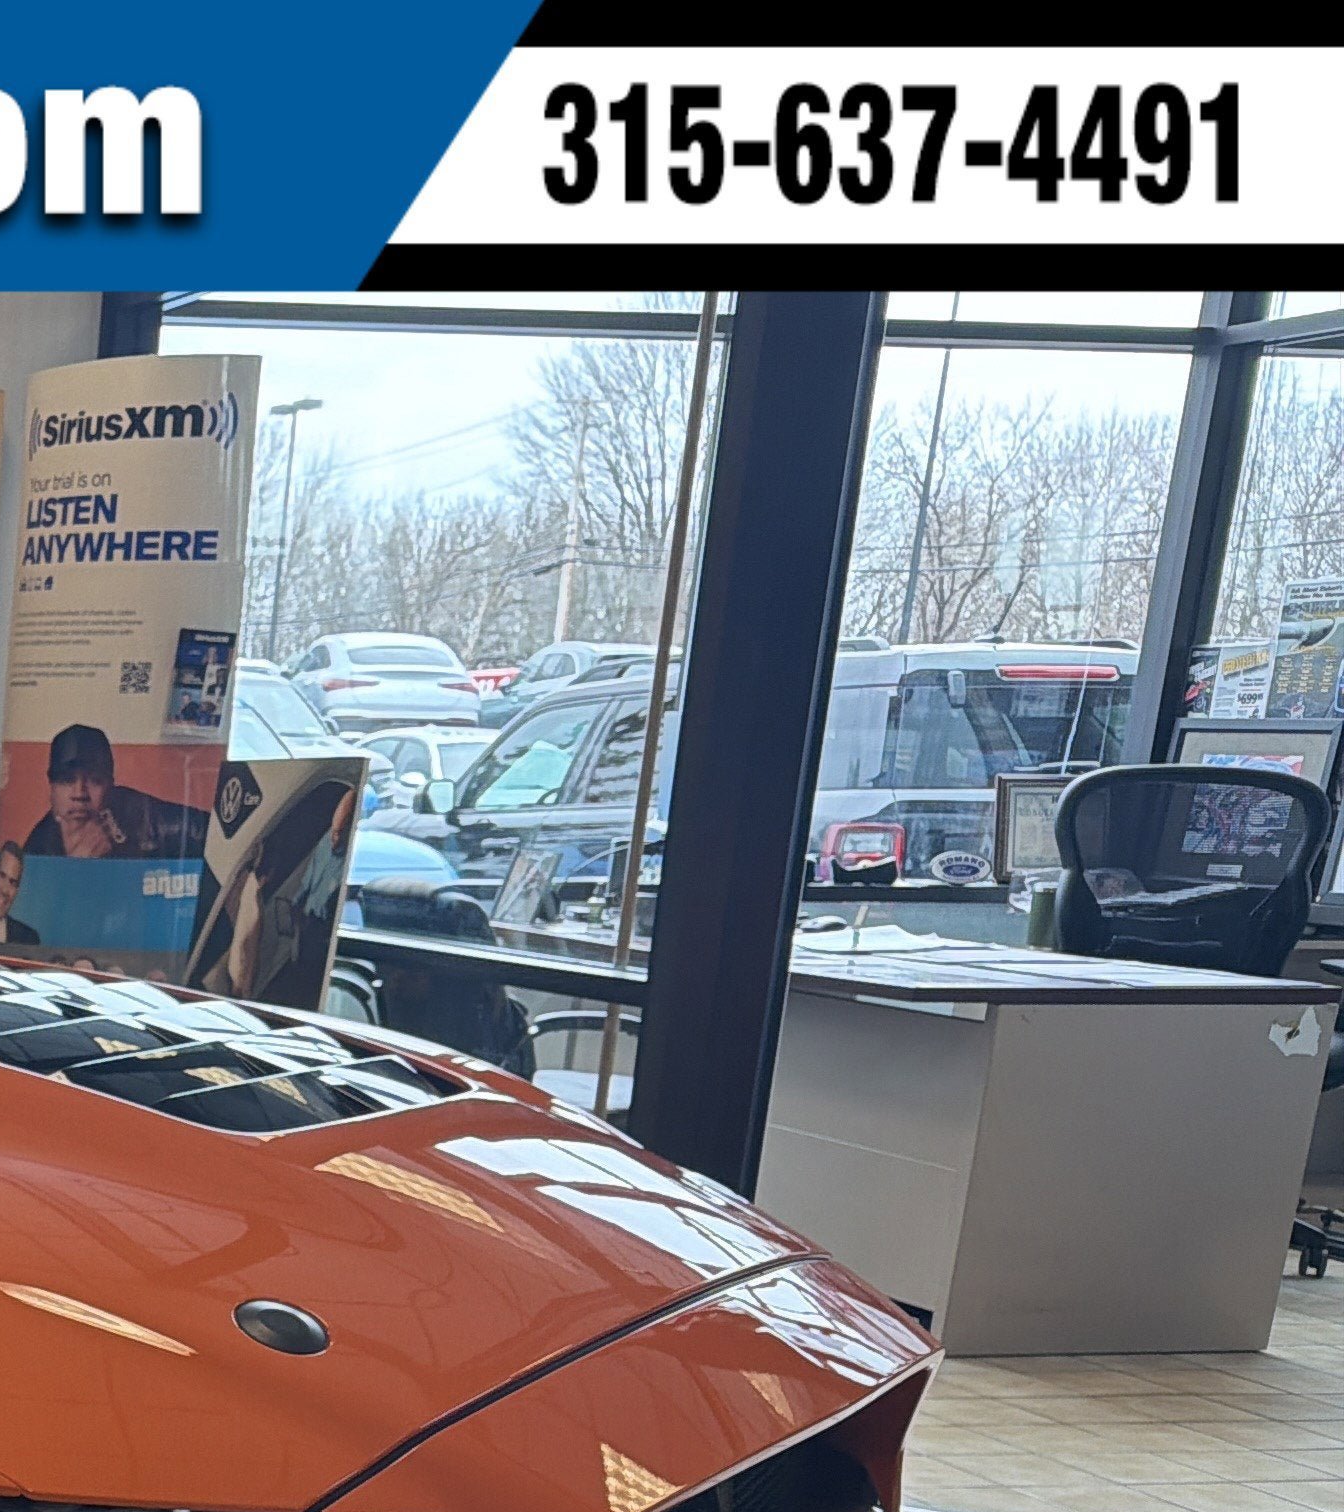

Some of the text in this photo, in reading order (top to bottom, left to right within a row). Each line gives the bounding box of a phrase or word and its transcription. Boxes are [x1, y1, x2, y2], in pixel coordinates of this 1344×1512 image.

[53, 473, 75, 489] trial
[77, 472, 88, 488] is
[91, 472, 112, 487] on
[26, 492, 119, 530] LISTEN
[22, 530, 220, 566] ANYWHERE
